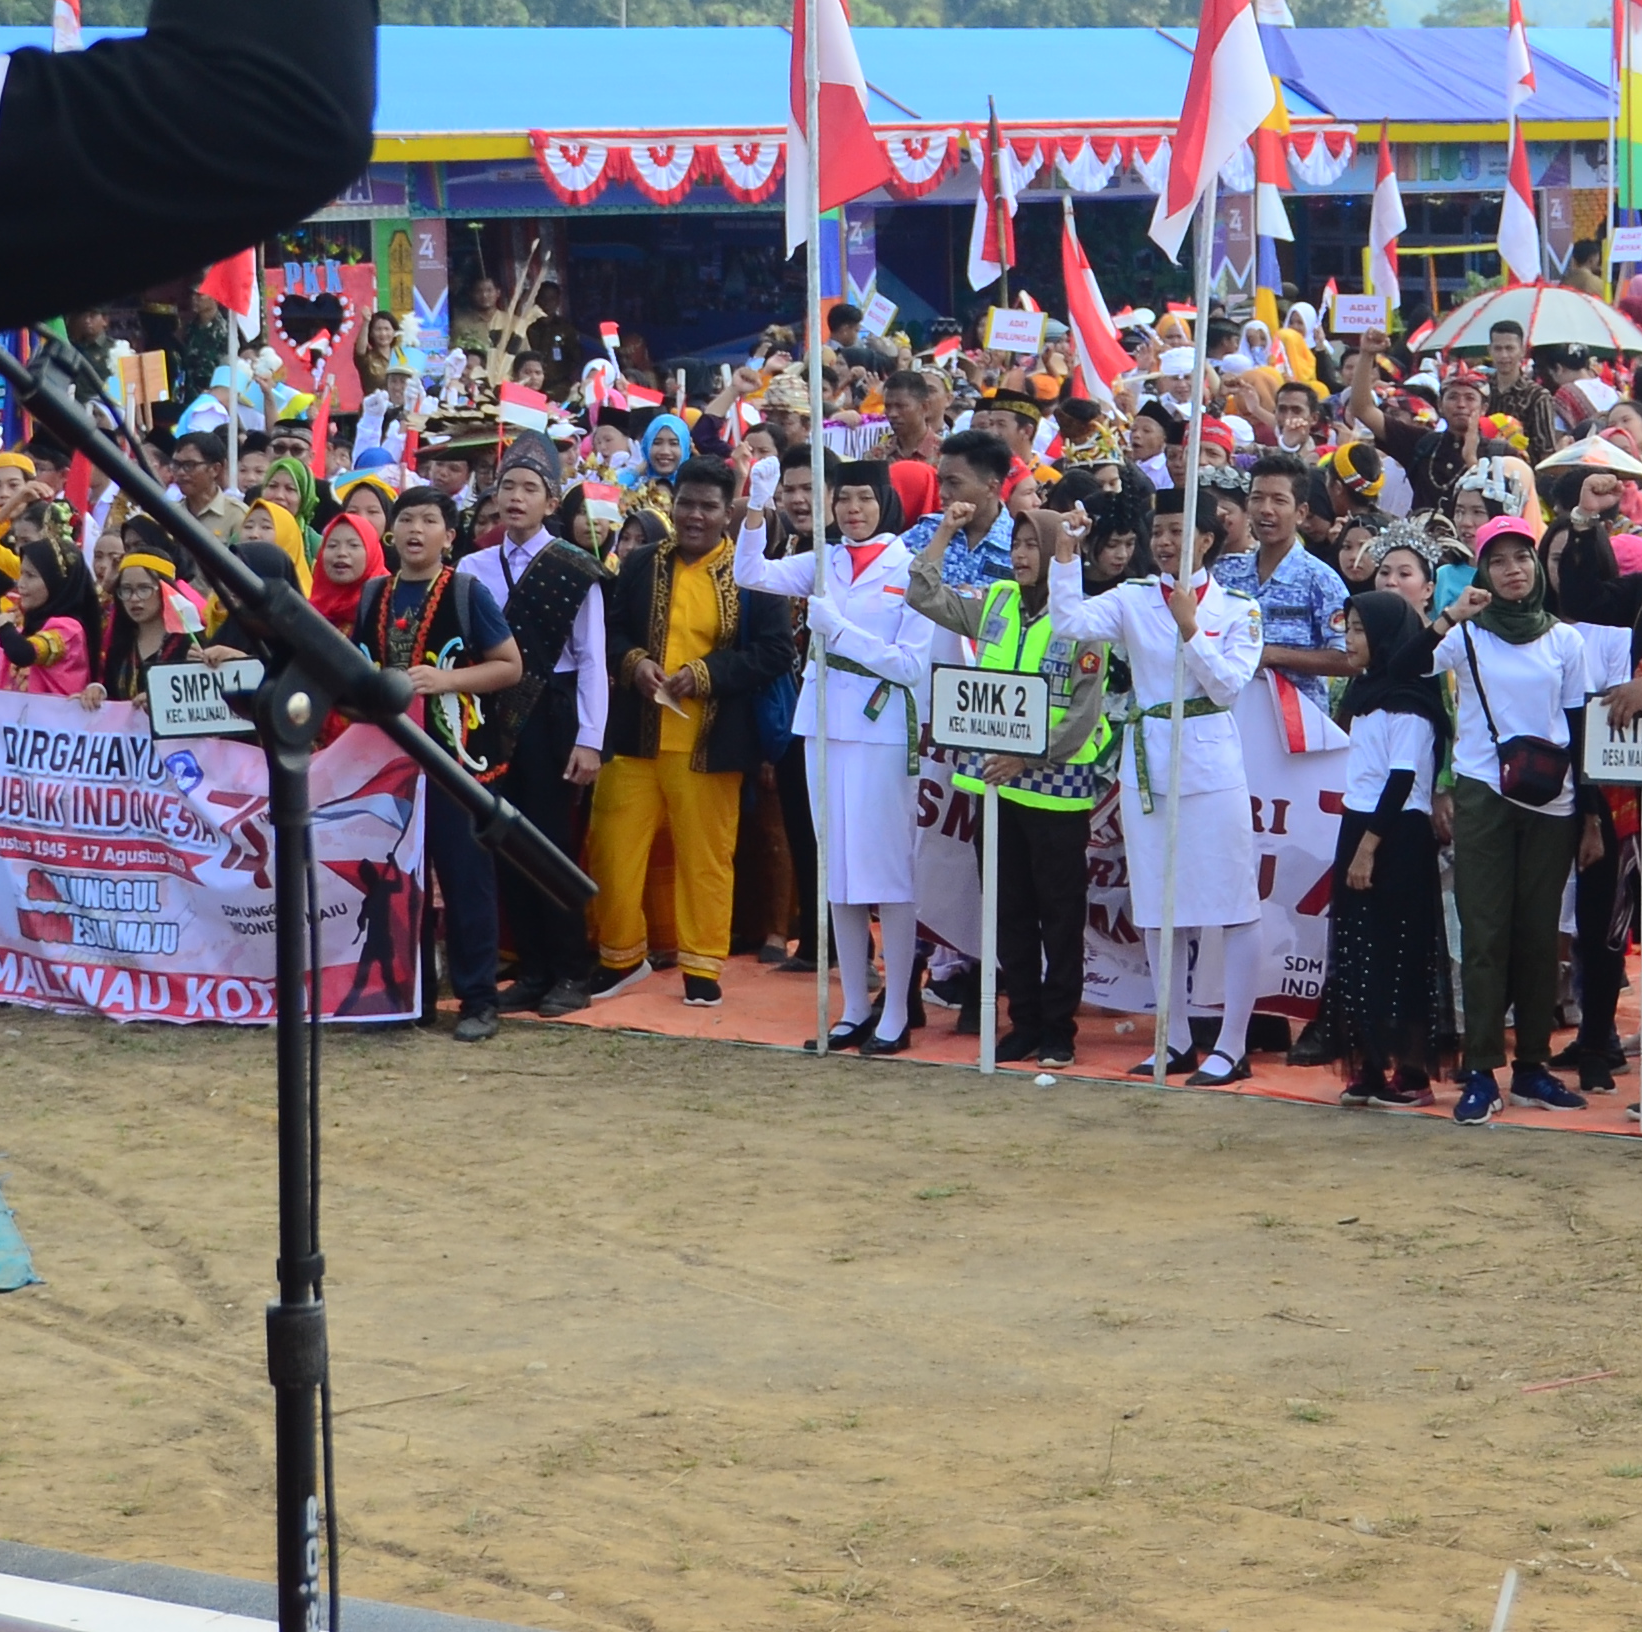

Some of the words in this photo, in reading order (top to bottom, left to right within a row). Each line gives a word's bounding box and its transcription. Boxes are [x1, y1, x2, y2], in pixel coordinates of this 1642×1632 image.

[284, 257, 342, 294] PKK
[1342, 316, 1384, 325] TORAJA
[170, 671, 224, 703] SMPN
[233, 670, 242, 689] 1
[957, 680, 1006, 716] SMK
[1014, 686, 1026, 717] 2
[165, 709, 186, 723] KEC.
[188, 706, 227, 722] MALINAU
[949, 715, 968, 734] KEC.
[970, 718, 1007, 737] MALINAU
[1010, 722, 1032, 740] KOTA
[1602, 748, 1625, 766] DESA
[73, 784, 218, 844] INDONESIA
[34, 840, 66, 859] 1945
[81, 845, 100, 861] 17
[103, 847, 166, 867] Agustus
[68, 875, 162, 912] UNGGUL
[244, 902, 276, 918] UNGG
[115, 920, 181, 956] MAJU
[1285, 956, 1323, 974] SDM
[184, 976, 275, 1018] KOT
